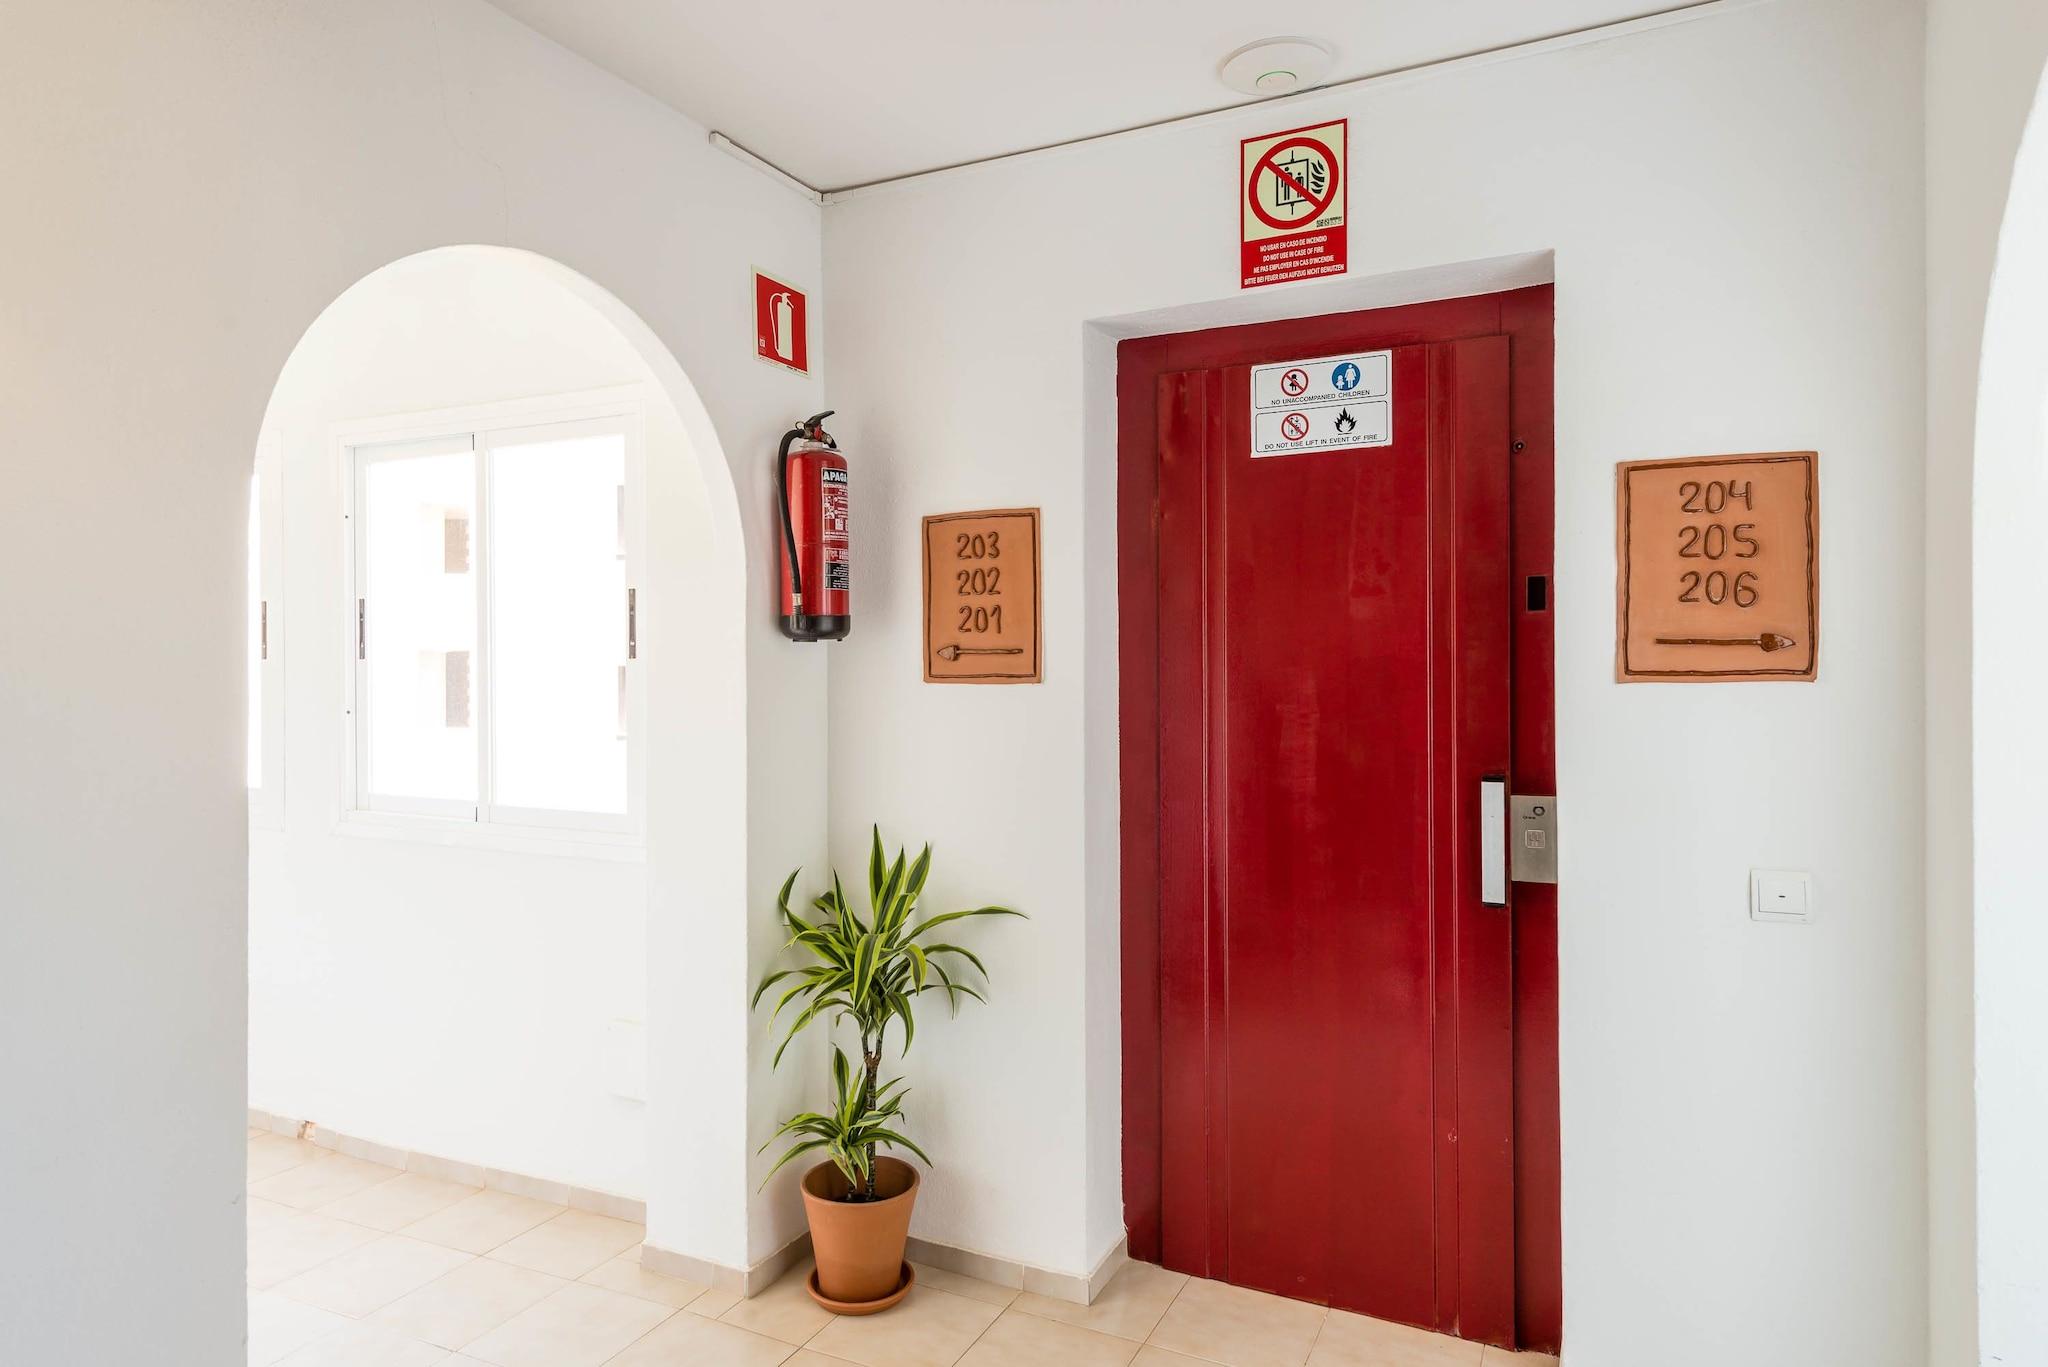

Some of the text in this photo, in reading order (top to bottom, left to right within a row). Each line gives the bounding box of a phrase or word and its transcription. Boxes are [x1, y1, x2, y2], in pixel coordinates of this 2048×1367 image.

[1267, 243, 1279, 251] USAR
[1306, 236, 1327, 245] INCENDIO
[1269, 261, 1292, 271] EMPLOYER
[1289, 270, 1306, 278] AUFZUG
[1282, 394, 1336, 404] UNACCOMPANIED
[1679, 480, 1753, 513] 204
[957, 532, 1000, 559] 203
[1678, 524, 1760, 560] 205
[957, 567, 1000, 595] 202
[1678, 570, 1759, 608] 206
[959, 605, 1001, 634] 201
